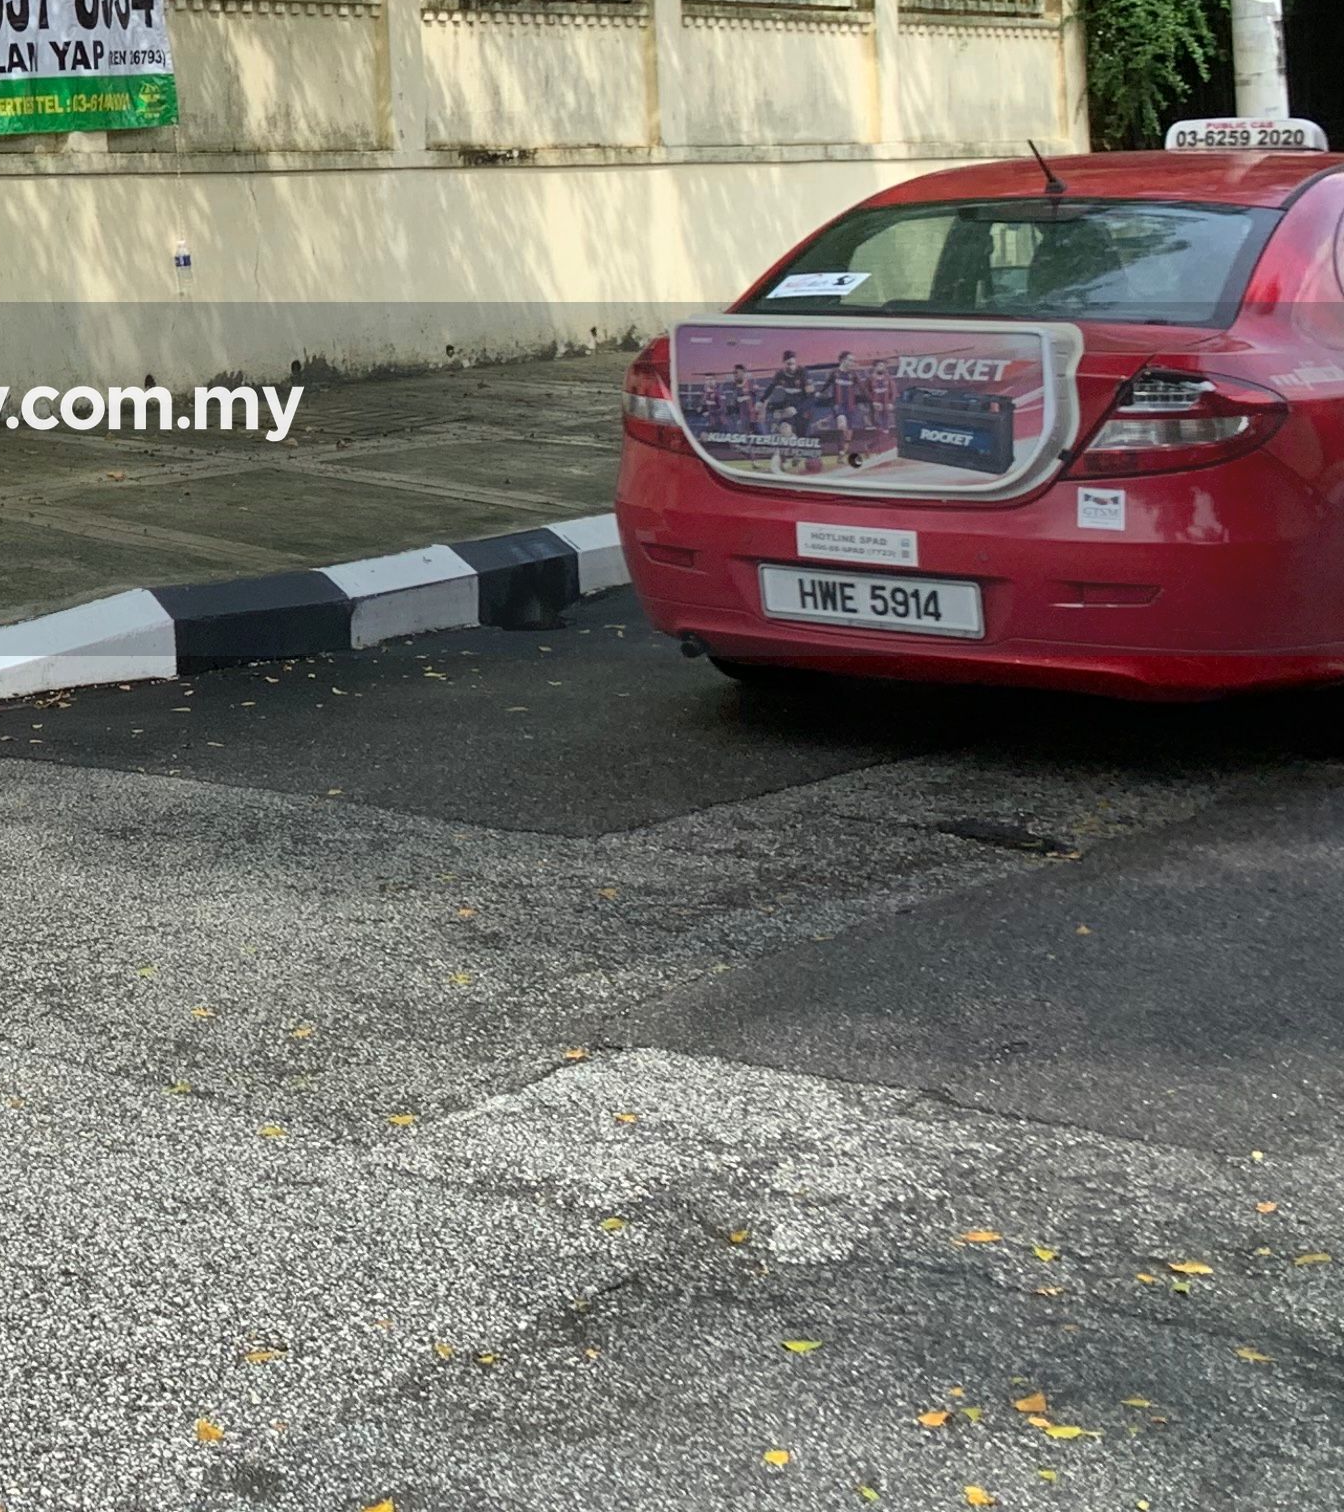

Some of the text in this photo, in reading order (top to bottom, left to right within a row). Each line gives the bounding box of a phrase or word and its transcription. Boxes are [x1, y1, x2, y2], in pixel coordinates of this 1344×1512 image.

[49, 40, 105, 71] YAP
[35, 94, 64, 114] TEL
[1176, 129, 1305, 147] 03-6259 2020
[894, 356, 1012, 381] ROCKET
[920, 428, 974, 447] ROCKET
[810, 532, 855, 544] HOTLINE
[798, 578, 942, 622] HWE 5914
